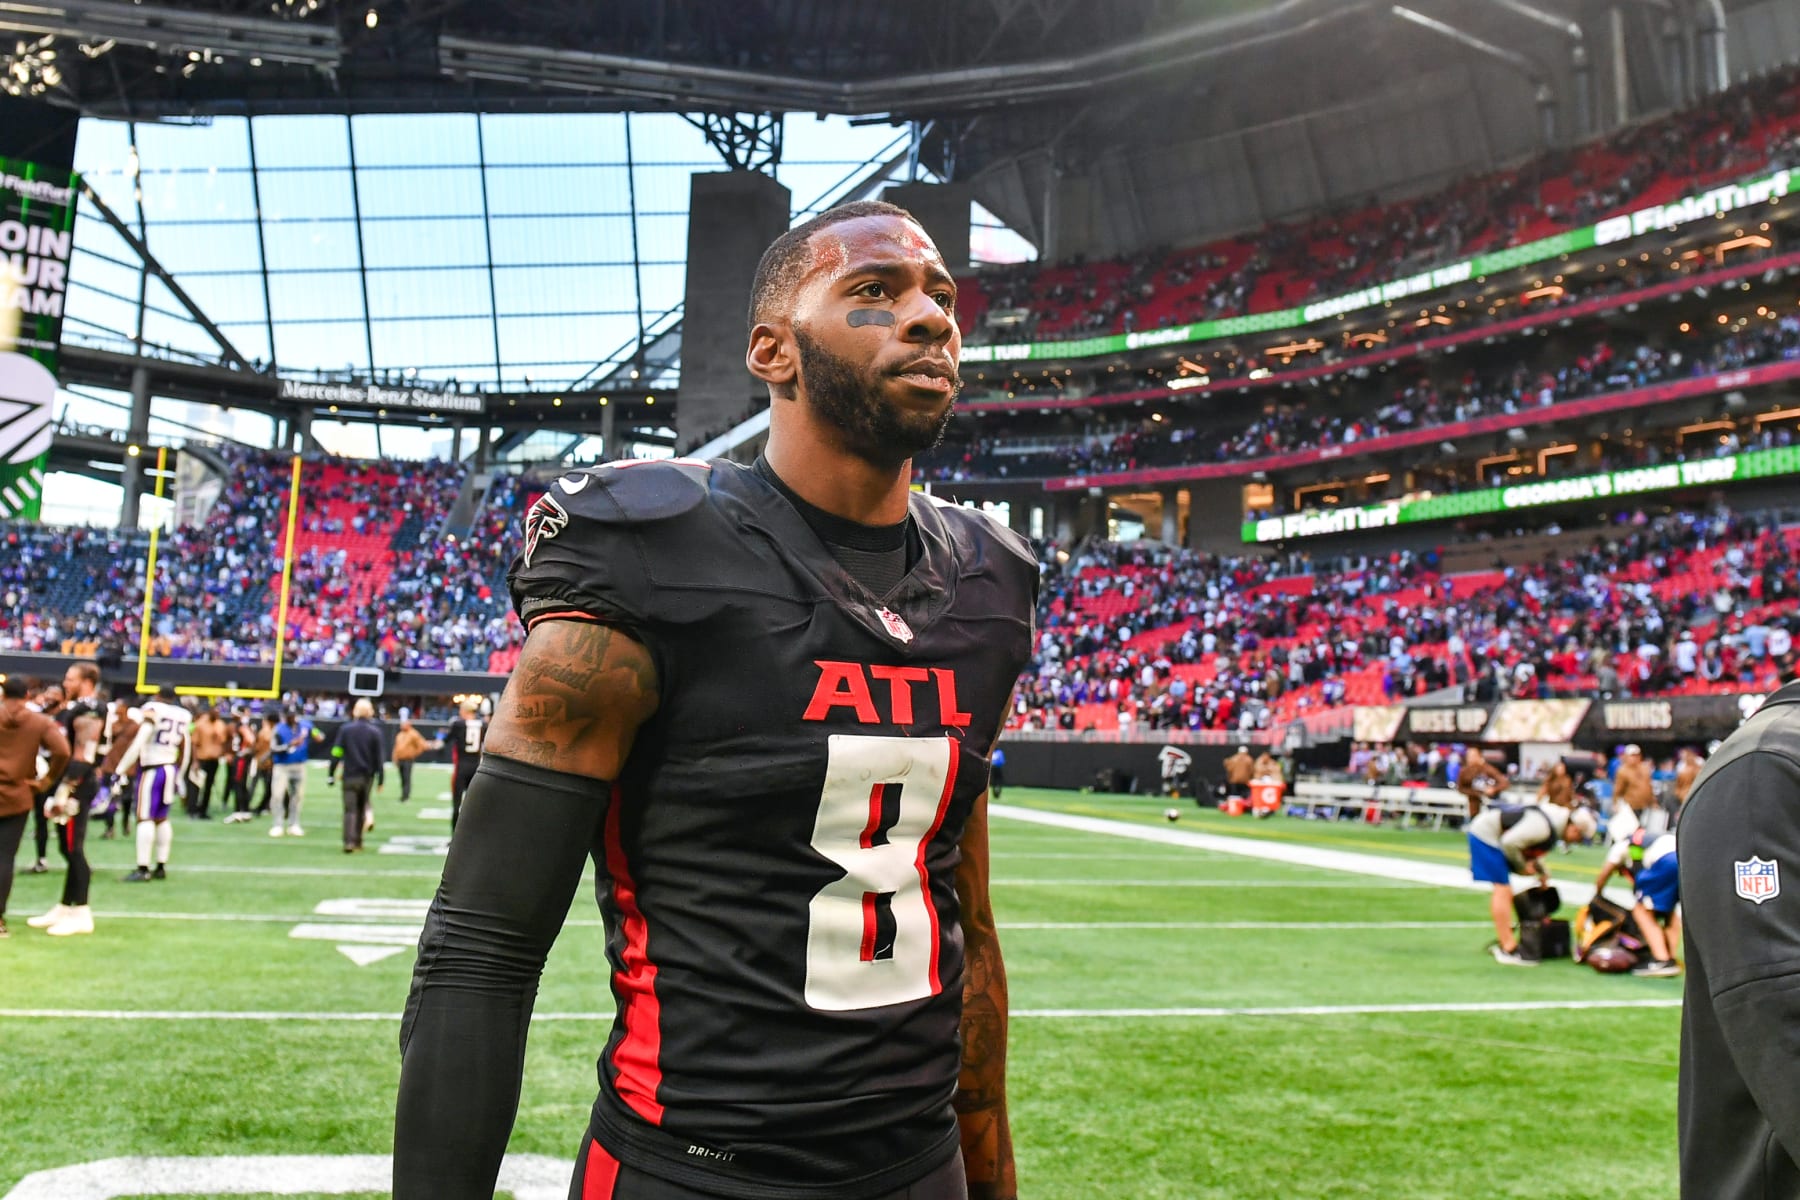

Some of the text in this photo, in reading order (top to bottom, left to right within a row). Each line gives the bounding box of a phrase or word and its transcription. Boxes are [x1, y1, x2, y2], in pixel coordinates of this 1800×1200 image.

[1632, 169, 1791, 236] FieldTurf
[2, 284, 63, 317] AM
[281, 379, 482, 411] Mercedes-Benz Stadium
[1283, 455, 1737, 539] FieldTurf GEORGIA'S HOME TURF
[802, 660, 972, 726] ATL
[1456, 707, 1488, 733] UP
[1603, 701, 1672, 730] VIKINGS
[156, 717, 187, 747] 25
[465, 719, 483, 753] 9
[804, 735, 960, 1011] 8
[1742, 876, 1773, 895] NFL
[686, 1144, 737, 1163] DRI-FIT
